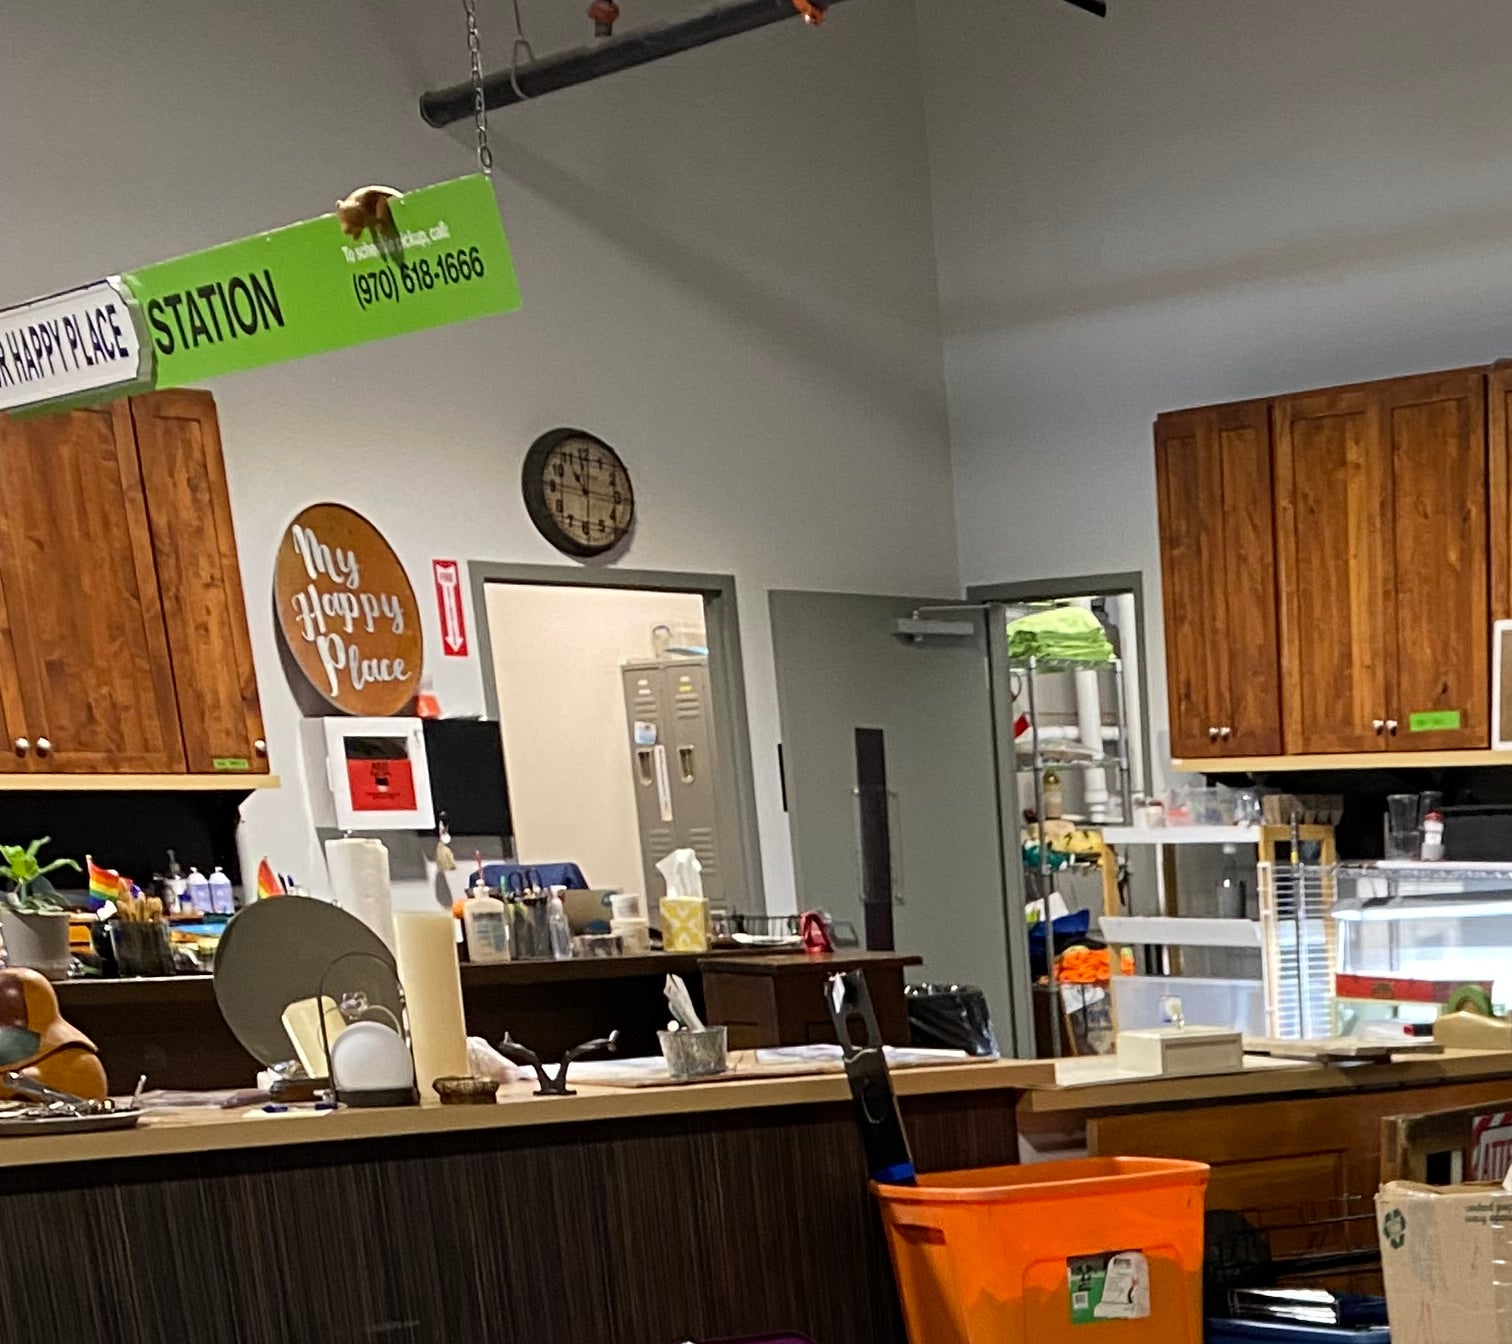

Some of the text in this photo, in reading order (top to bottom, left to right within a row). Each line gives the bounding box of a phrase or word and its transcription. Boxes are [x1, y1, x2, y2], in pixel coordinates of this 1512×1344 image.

[353, 265, 399, 311] (970)
[401, 246, 484, 294] 618-1666
[5, 319, 69, 381] HAPPY
[63, 304, 129, 370] PLACE
[147, 269, 285, 355] STATION
[292, 523, 359, 589] My
[292, 584, 404, 641] Happy
[316, 632, 413, 697] Place
